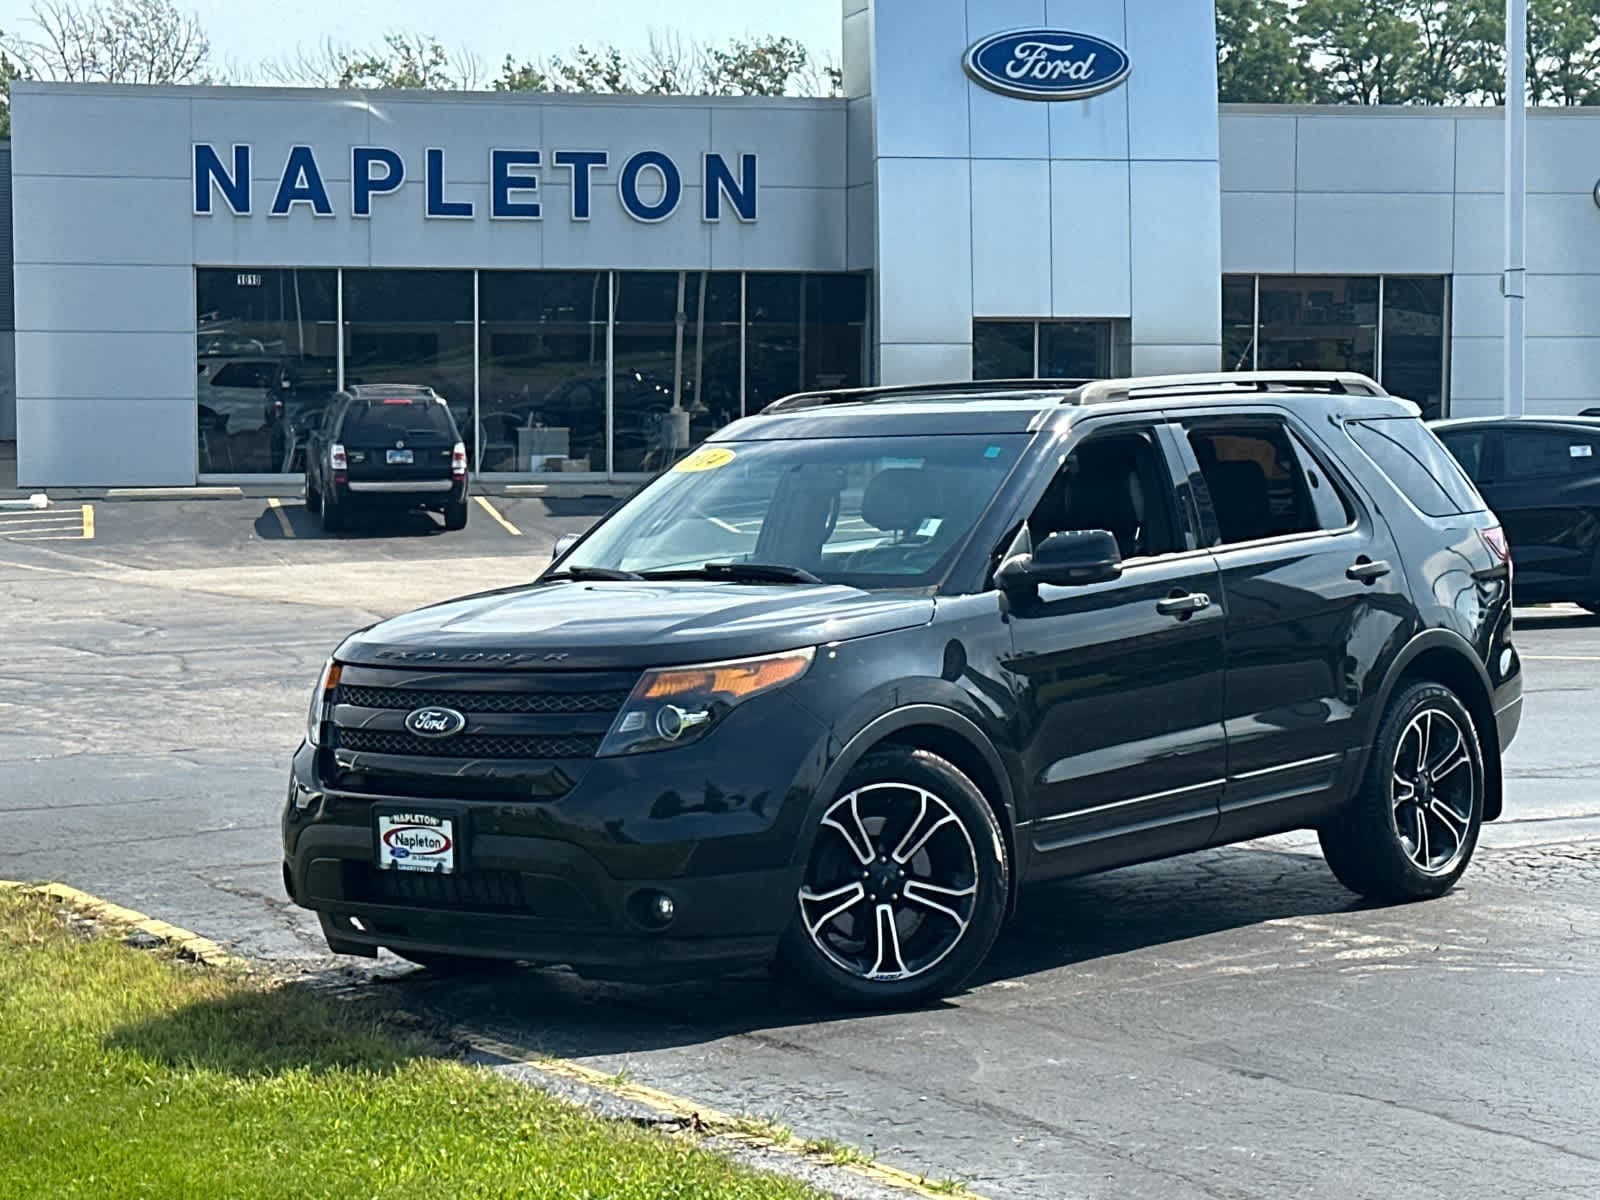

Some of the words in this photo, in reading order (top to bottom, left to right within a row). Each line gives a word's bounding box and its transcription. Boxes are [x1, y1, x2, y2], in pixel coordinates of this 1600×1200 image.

[1005, 41, 1097, 80] Ford
[192, 143, 758, 222] NAPLETON
[414, 711, 449, 732] Ford
[392, 813, 440, 825] NAPLETON
[394, 831, 441, 850] Napleton
